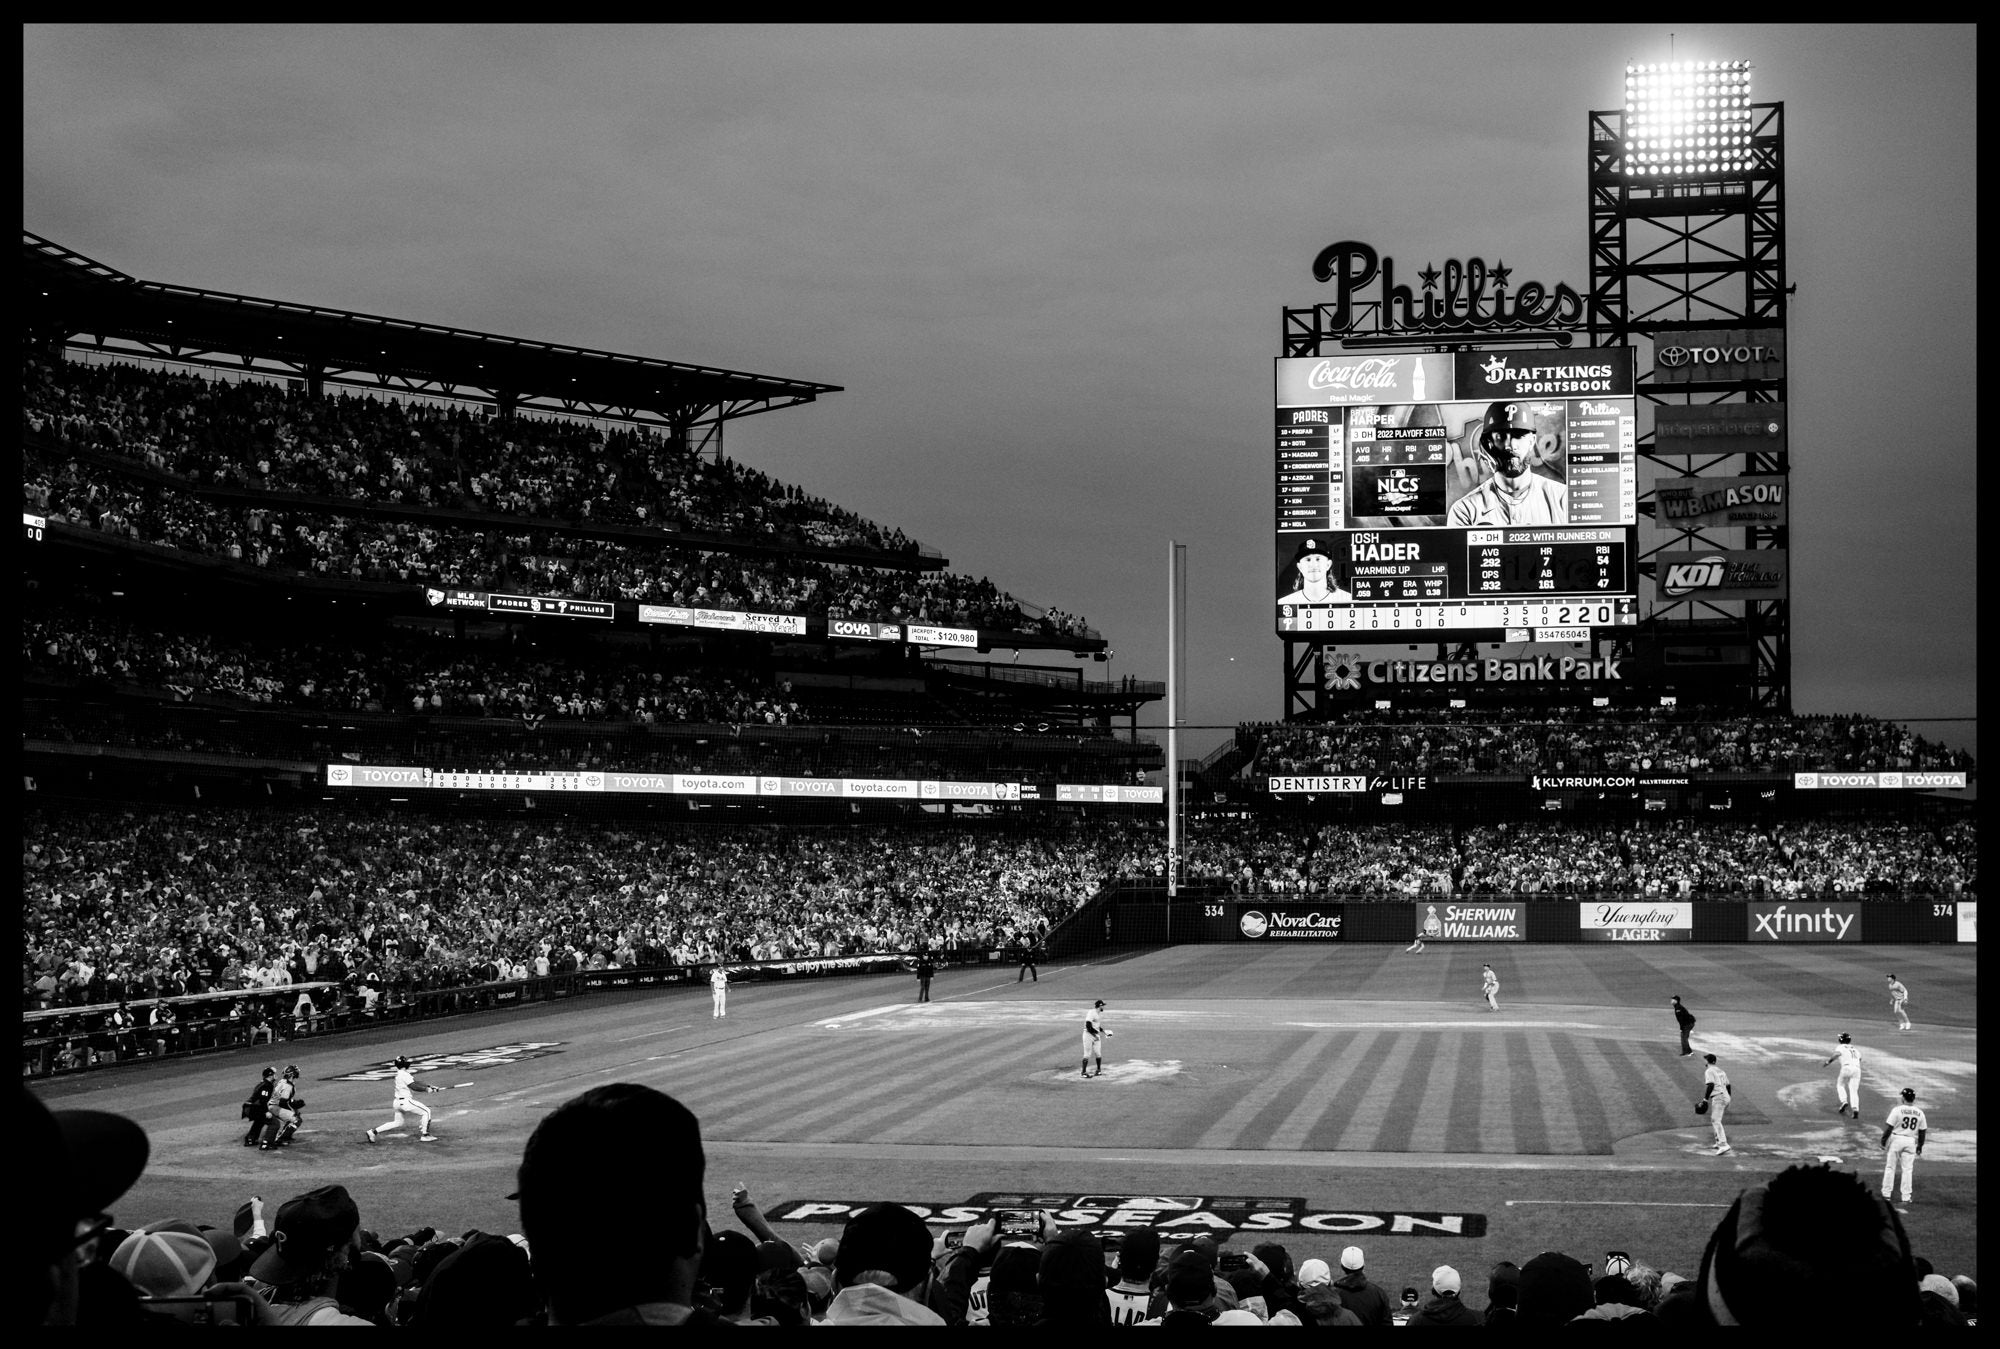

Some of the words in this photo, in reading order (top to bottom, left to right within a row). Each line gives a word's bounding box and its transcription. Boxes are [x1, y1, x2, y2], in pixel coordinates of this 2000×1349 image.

[1312, 240, 1583, 331] Phillies
[1689, 346, 1779, 364] TOYOTA
[1308, 358, 1400, 390] Coca-Cola
[1485, 365, 1612, 384] DRAFTKINGS
[1516, 380, 1611, 393] SPORTSBOOK
[1349, 394, 1373, 402] Magic
[1579, 401, 1620, 415] Phillies
[1293, 410, 1328, 424] PADRES
[1351, 415, 1395, 425] HARPER
[1395, 429, 1424, 437] PLAYOFF
[1377, 478, 1419, 493] NLCS
[1351, 533, 1379, 545] JOSH
[1472, 534, 1477, 542] 3
[1486, 534, 1499, 542] DH
[1509, 534, 1530, 542] 2022
[1532, 533, 1554, 541] WITH
[1556, 532, 1597, 541] RUNNERS
[1599, 531, 1611, 540] ON
[1352, 544, 1420, 561] HADER
[1481, 549, 1499, 557] AVG
[1596, 546, 1610, 554] RBI
[1480, 558, 1500, 567] .292
[1543, 557, 1549, 566] 7
[1597, 556, 1609, 565] 54
[1355, 567, 1396, 575] WARMING
[1399, 566, 1410, 574] UP
[1482, 571, 1499, 579] OPS
[1541, 570, 1552, 578] AB
[1664, 564, 1725, 587] KDI
[1480, 581, 1501, 590] .932
[1538, 580, 1554, 589] 161
[1597, 579, 1609, 588] 47
[457, 592, 474, 600] MLB
[447, 598, 485, 607] NETWORK
[497, 600, 528, 608] PADRES
[570, 605, 604, 614] PHILLIES
[1306, 610, 1312, 618] 0
[1328, 610, 1333, 618] 0
[1394, 609, 1399, 617] 0
[1416, 608, 1421, 616] 0
[1438, 608, 1444, 616] 2
[1460, 608, 1466, 616] 0
[1503, 607, 1509, 615] 3
[1522, 607, 1528, 615] 5
[1542, 606, 1547, 614] 0
[1559, 607, 1570, 623] 2
[1579, 607, 1590, 623] 2
[1598, 606, 1609, 622] 0
[745, 613, 780, 623] Served
[784, 616, 796, 624] At
[1306, 621, 1312, 629] 0
[1328, 621, 1333, 629] 0
[1372, 620, 1377, 628] 0
[1394, 620, 1399, 628] 0
[1416, 620, 1421, 628] 0
[1439, 619, 1444, 627] 0
[1503, 618, 1509, 626] 2
[1523, 617, 1528, 625] 5
[1542, 617, 1547, 625] 0
[834, 622, 871, 635] GOYA
[938, 632, 975, 643] $120,980
[1539, 631, 1587, 639] 354765045
[1367, 659, 1477, 683] Citizens
[1484, 656, 1554, 681] Bank
[1560, 656, 1621, 680] Park
[363, 771, 419, 782] TOYOTA
[614, 777, 665, 788] TOYOTA
[1543, 777, 1635, 788] KLYRRUM.COM
[1821, 776, 1876, 786] TOYOTA
[1906, 775, 1961, 785] TOYOTA
[682, 778, 745, 790] toyota.com
[789, 782, 836, 792] TOYOTA
[851, 782, 907, 794] toyota.com
[947, 785, 989, 795] TOYOTA
[1271, 778, 1362, 790] DENTISTRY
[1369, 777, 1388, 791] for
[1393, 778, 1426, 790] LIFE
[1124, 790, 1160, 799] TOYOTA
[1204, 905, 1224, 917] 334
[1445, 906, 1515, 921] SHERWIN
[1594, 904, 1678, 927] Yuengling
[1933, 905, 1953, 917] 374
[1269, 912, 1339, 926] NovaCare
[1755, 905, 1854, 940] xfinity
[1270, 929, 1338, 938] REHABILITATION
[1611, 929, 1660, 941] LAGER
[797, 961, 819, 973] enjoy
[822, 960, 835, 970] the
[1901, 1117, 1918, 1130] 38
